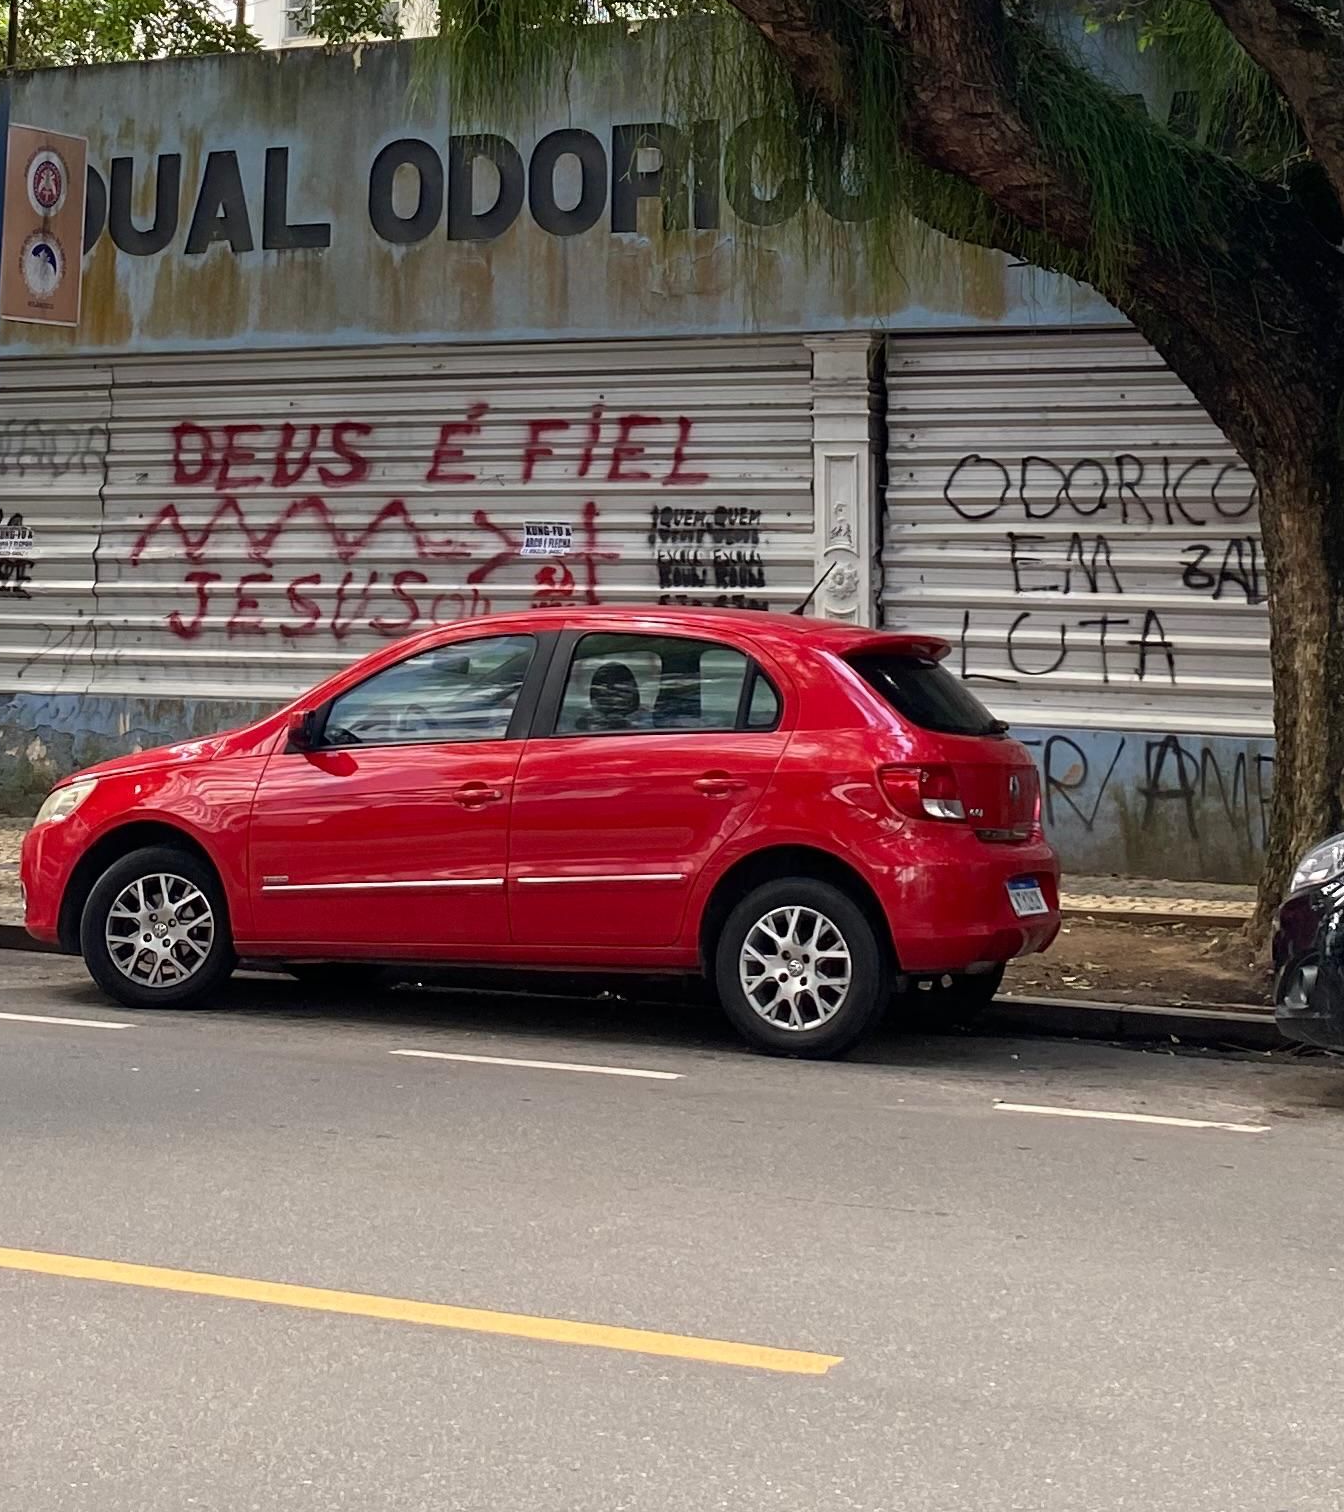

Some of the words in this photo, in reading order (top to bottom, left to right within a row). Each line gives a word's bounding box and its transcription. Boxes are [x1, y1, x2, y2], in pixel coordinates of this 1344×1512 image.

[173, 420, 372, 490] DEUS
[425, 402, 491, 483] É
[522, 402, 710, 485] FIEL
[944, 453, 1259, 526] ODORICO
[1006, 531, 1124, 594] EM
[167, 570, 429, 640] JESUS
[961, 610, 1177, 685] LUTA
